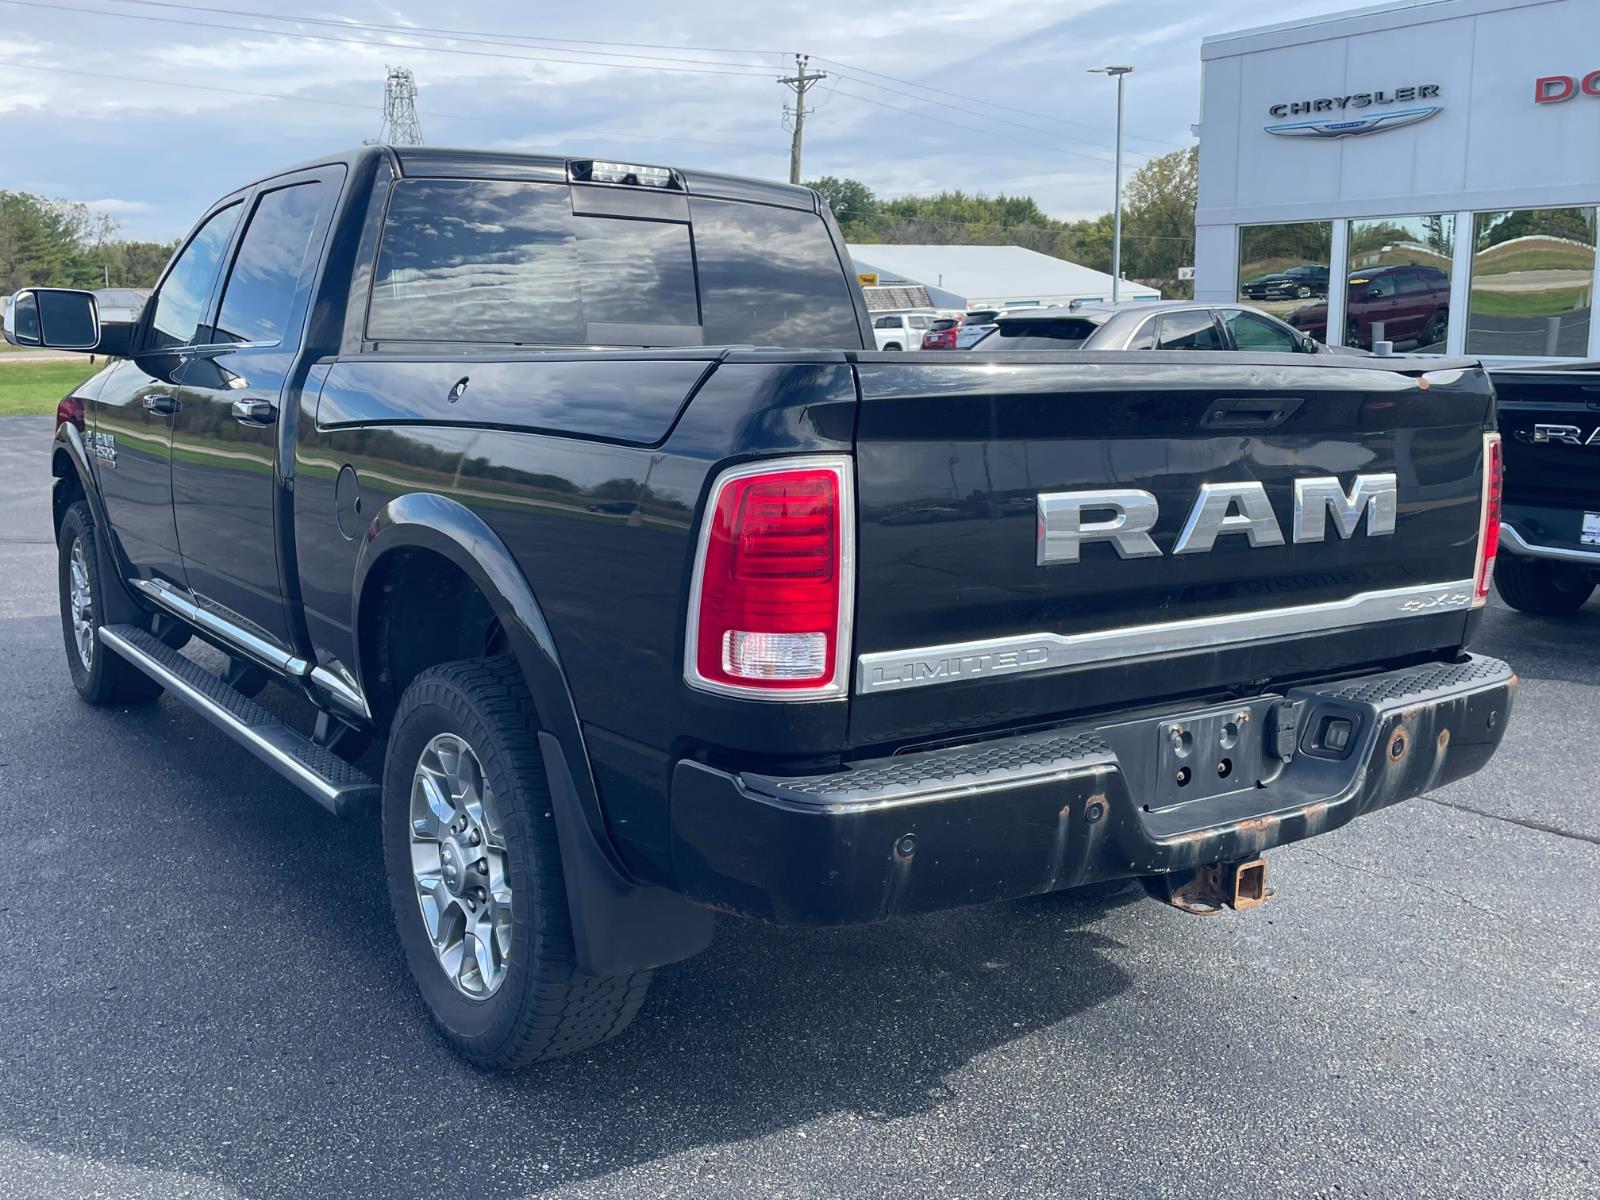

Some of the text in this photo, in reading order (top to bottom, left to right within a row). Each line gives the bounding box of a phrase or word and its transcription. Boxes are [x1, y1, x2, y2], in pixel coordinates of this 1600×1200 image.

[1269, 84, 1440, 118] CHRYSLER
[1036, 473, 1397, 566] RAM
[872, 646, 1049, 686] LIMITED
